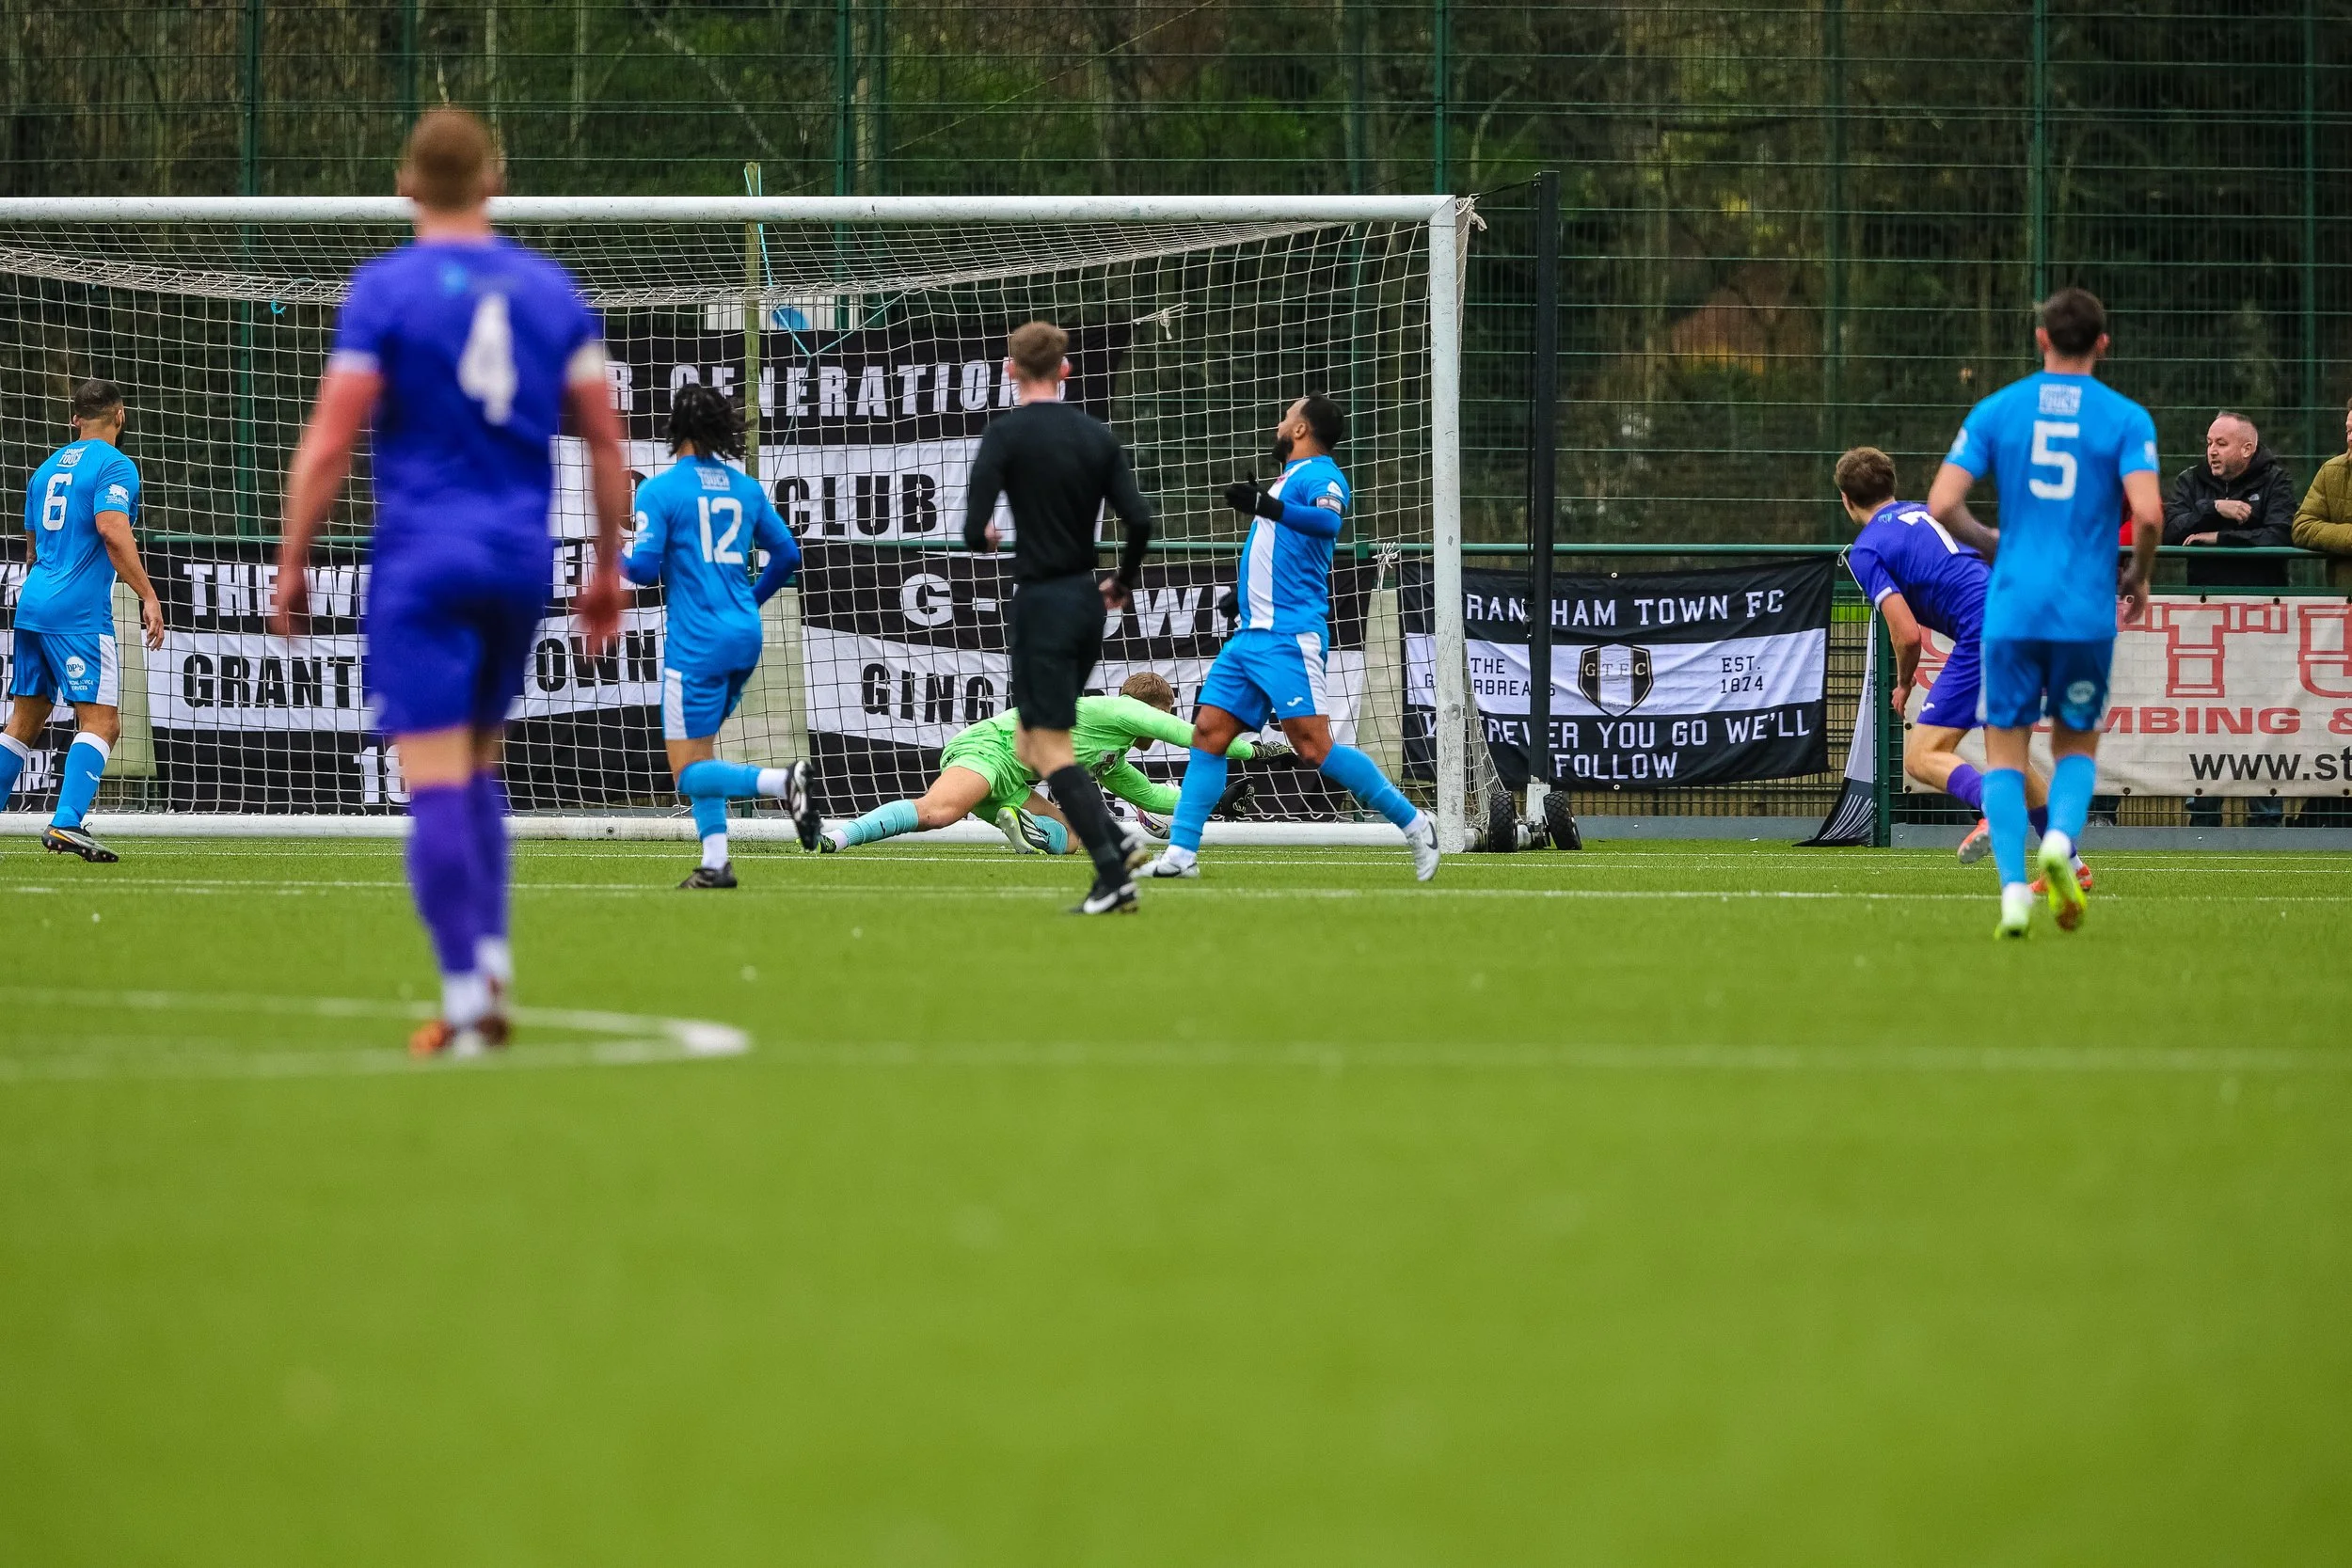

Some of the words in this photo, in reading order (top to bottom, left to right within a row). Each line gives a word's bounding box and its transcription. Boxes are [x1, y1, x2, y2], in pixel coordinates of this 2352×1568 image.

[457, 293, 516, 424] 4
[2029, 420, 2080, 499] 5
[42, 472, 72, 531] 6
[775, 472, 937, 536] CLUB
[698, 497, 744, 563] 12
[183, 564, 279, 617] THE
[1466, 594, 1616, 626] RANHAM
[1634, 594, 1728, 626] TOWN
[1745, 589, 1785, 618] FC
[535, 628, 659, 692] OWN
[1470, 657, 1505, 674] THE
[1720, 675, 1764, 694] 1874
[1722, 656, 1761, 673] EST.
[1597, 721, 1655, 749] YOU
[1672, 720, 1708, 746] GO
[1725, 709, 1810, 744] WE'LL
[1554, 752, 1677, 780] FOLLOW
